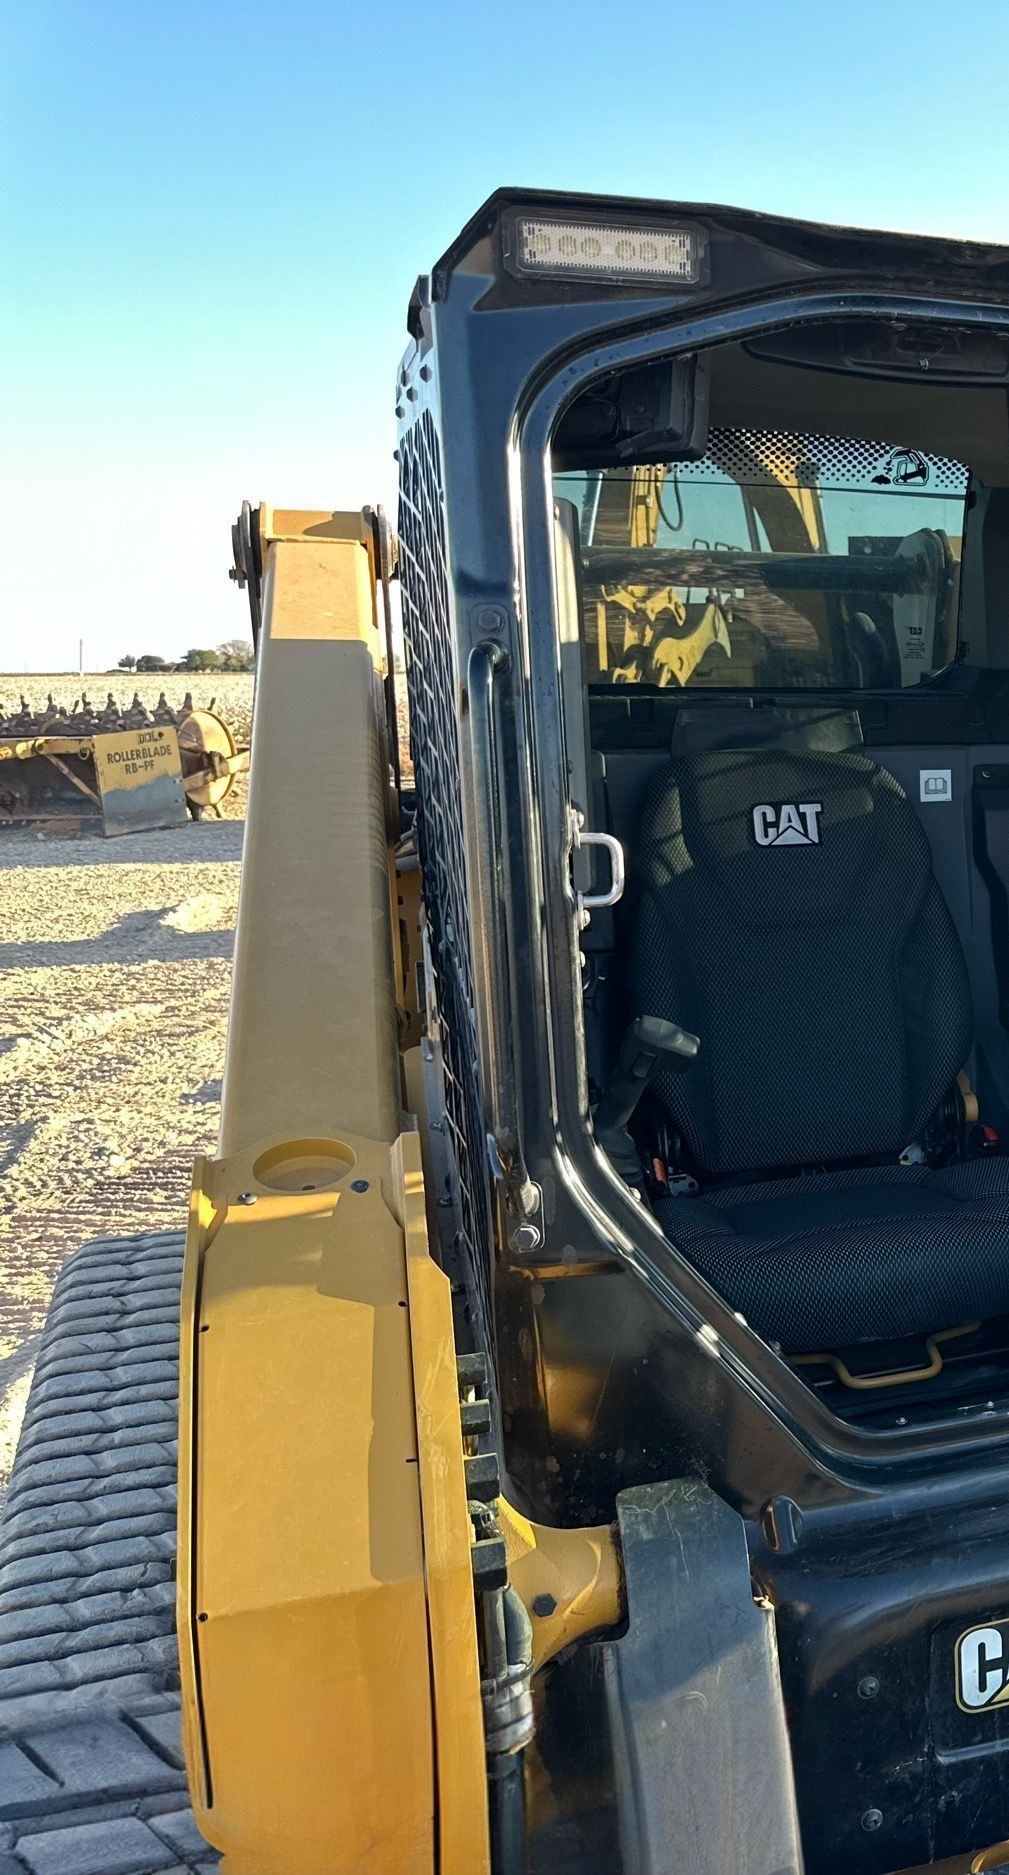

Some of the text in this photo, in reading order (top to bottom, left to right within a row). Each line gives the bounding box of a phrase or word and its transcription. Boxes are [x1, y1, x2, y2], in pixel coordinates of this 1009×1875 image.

[107, 745, 172, 764] ROLLERBLADE
[125, 760, 155, 774] RB-PF
[753, 804, 821, 846] CAT
